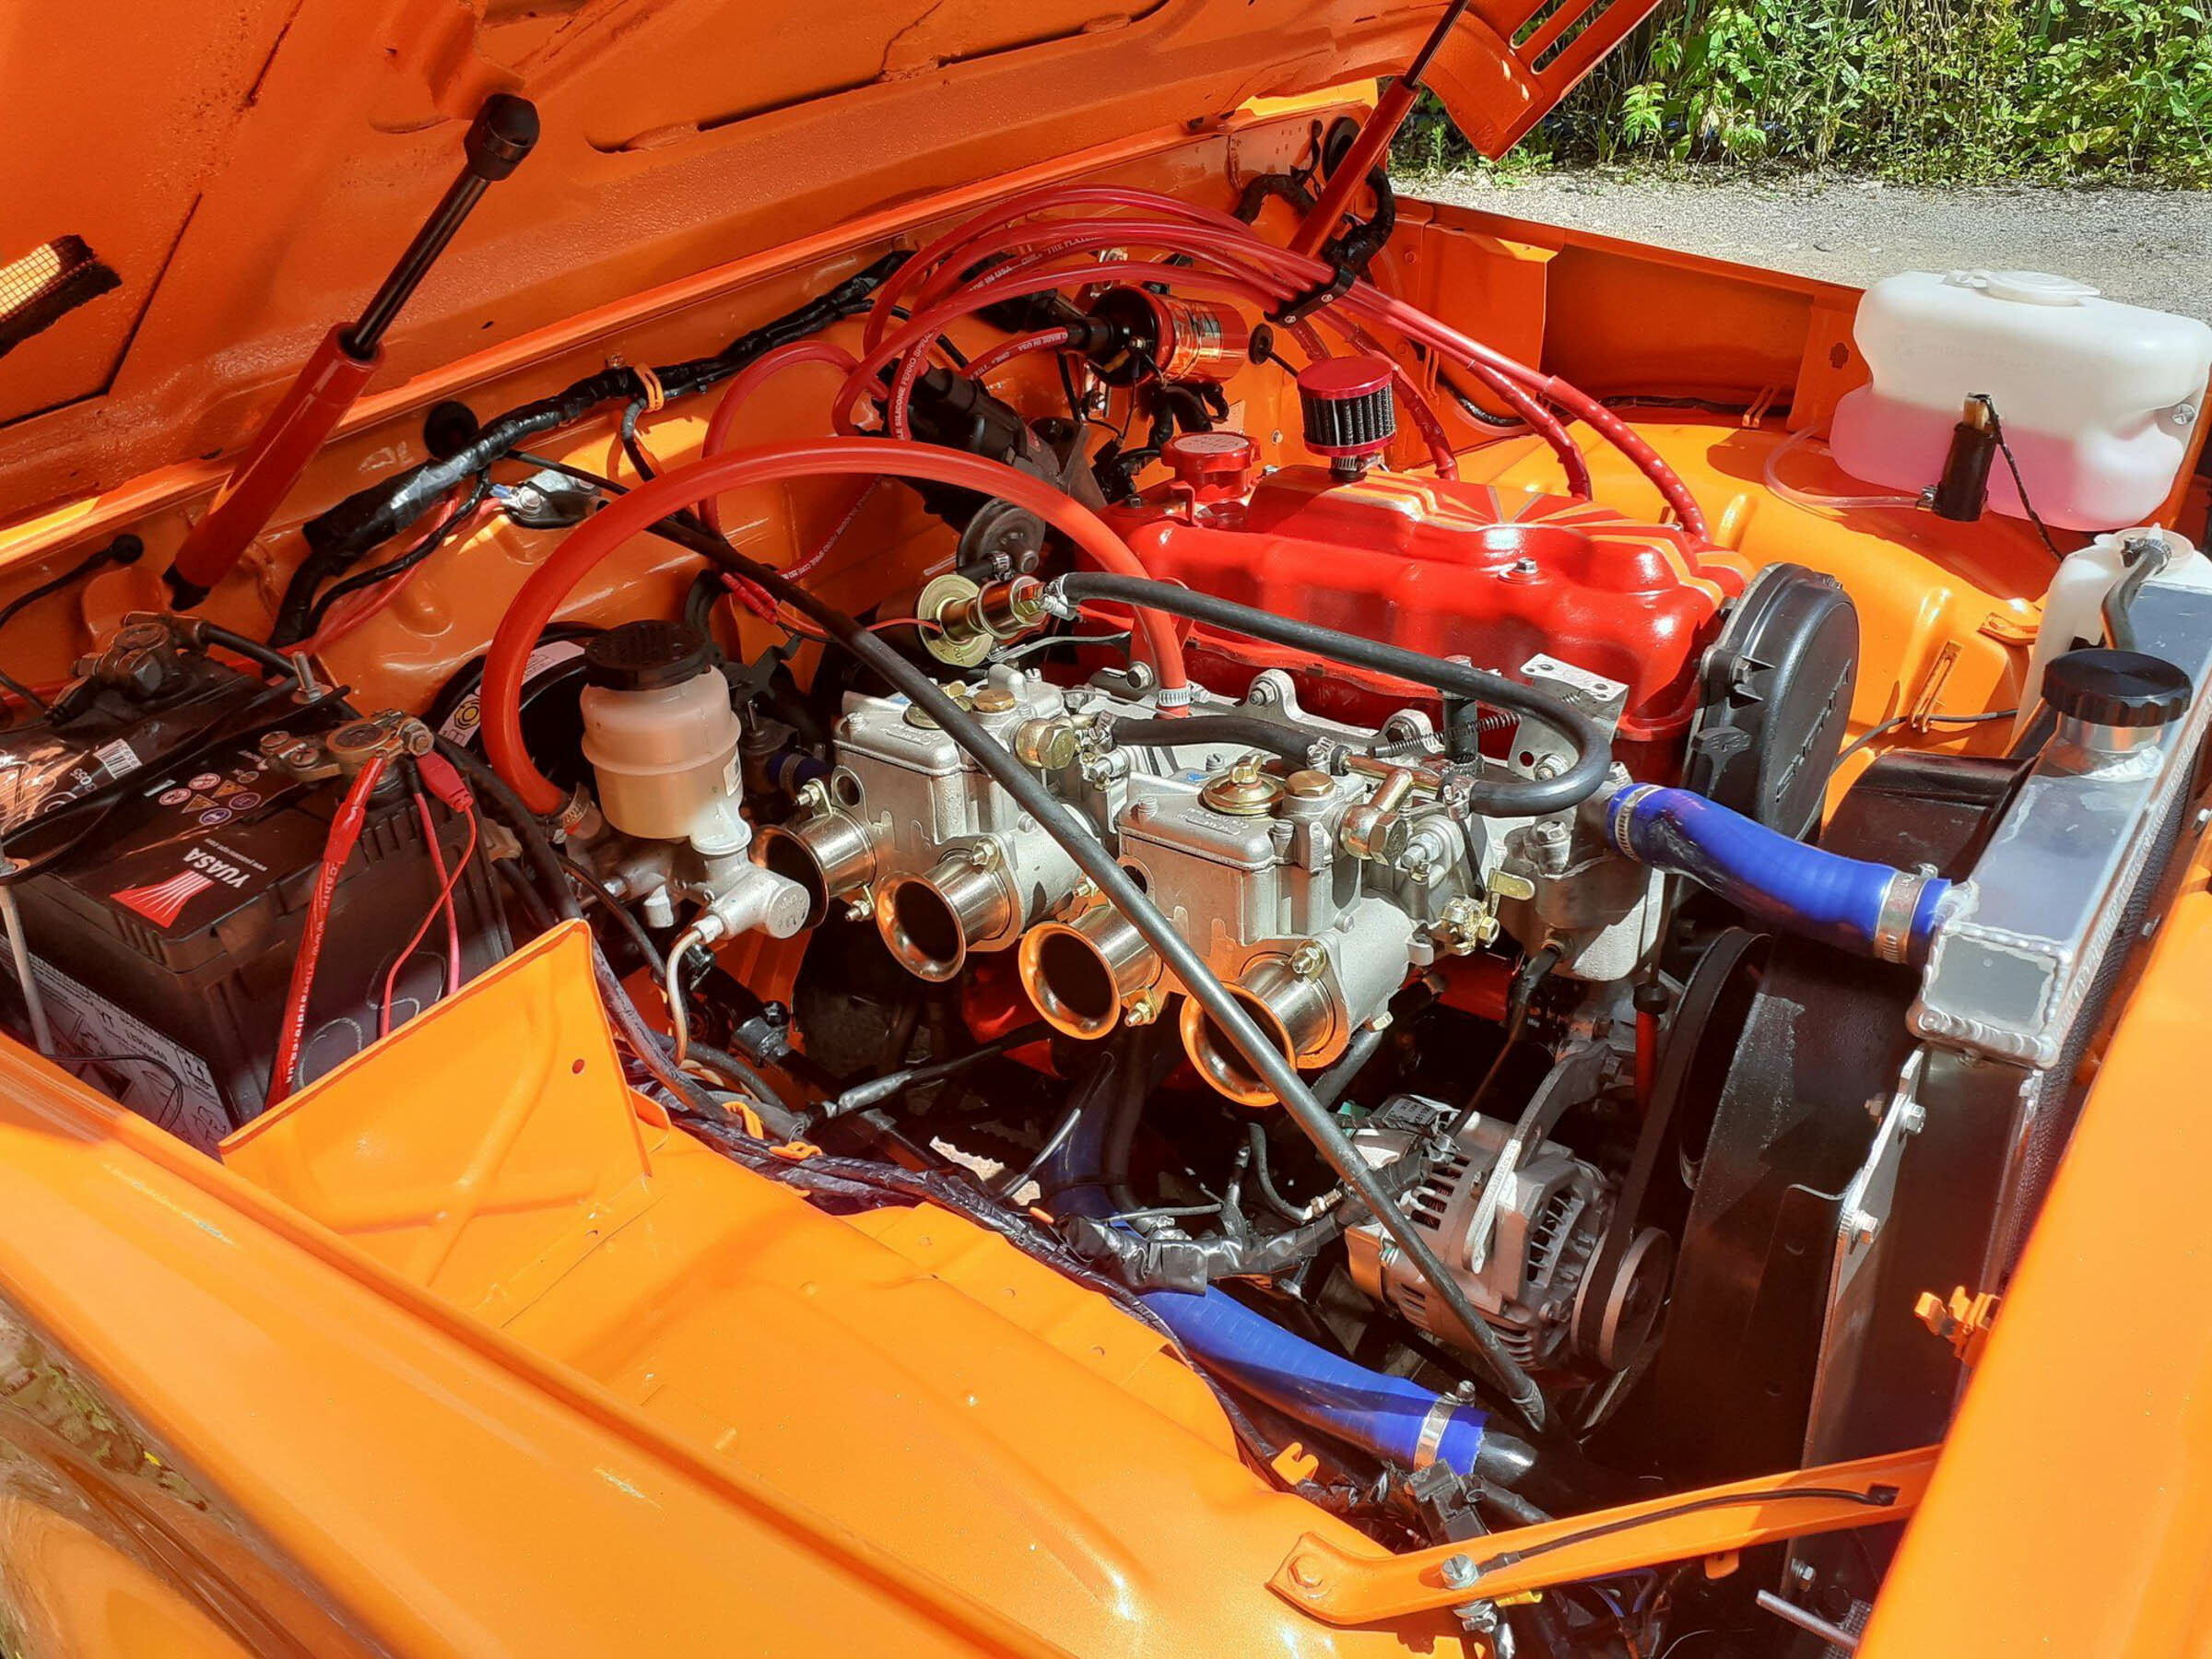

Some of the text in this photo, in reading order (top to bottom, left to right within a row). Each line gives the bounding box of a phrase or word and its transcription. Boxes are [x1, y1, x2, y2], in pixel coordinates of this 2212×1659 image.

[900, 357, 917, 385] FERRO
[895, 385, 906, 427] SILICONE
[182, 847, 251, 888] YUASA
